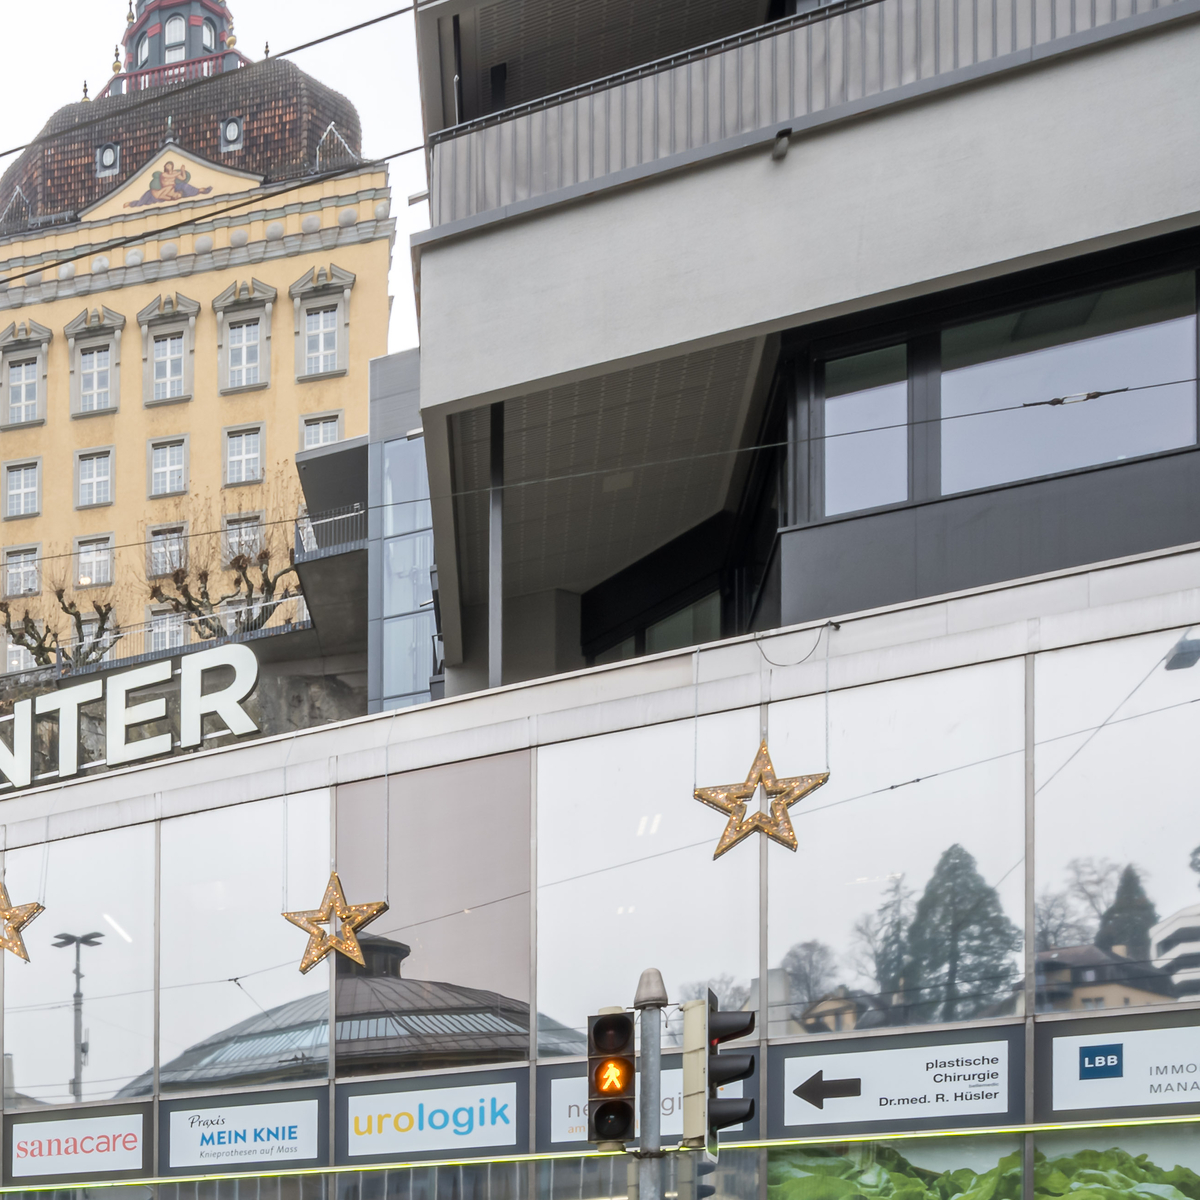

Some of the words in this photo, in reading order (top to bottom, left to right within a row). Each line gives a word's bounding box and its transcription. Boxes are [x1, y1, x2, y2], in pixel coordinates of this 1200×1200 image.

[925, 1056, 999, 1071] plastische
[1084, 1055, 1118, 1068] LBB
[933, 1070, 999, 1083] Chirurgie
[879, 1095, 931, 1106] Dr.med.
[935, 1093, 949, 1103] R.
[954, 1090, 1000, 1101] Hüsler
[188, 1114, 226, 1129] Praxis
[354, 1097, 510, 1136] urologik
[200, 1129, 247, 1147] MEIN
[253, 1125, 298, 1143] KNIE
[16, 1132, 138, 1159] sanacare
[199, 1148, 257, 1160] Knieprothesen
[260, 1145, 275, 1156] auf
[276, 1144, 298, 1154] Mass
